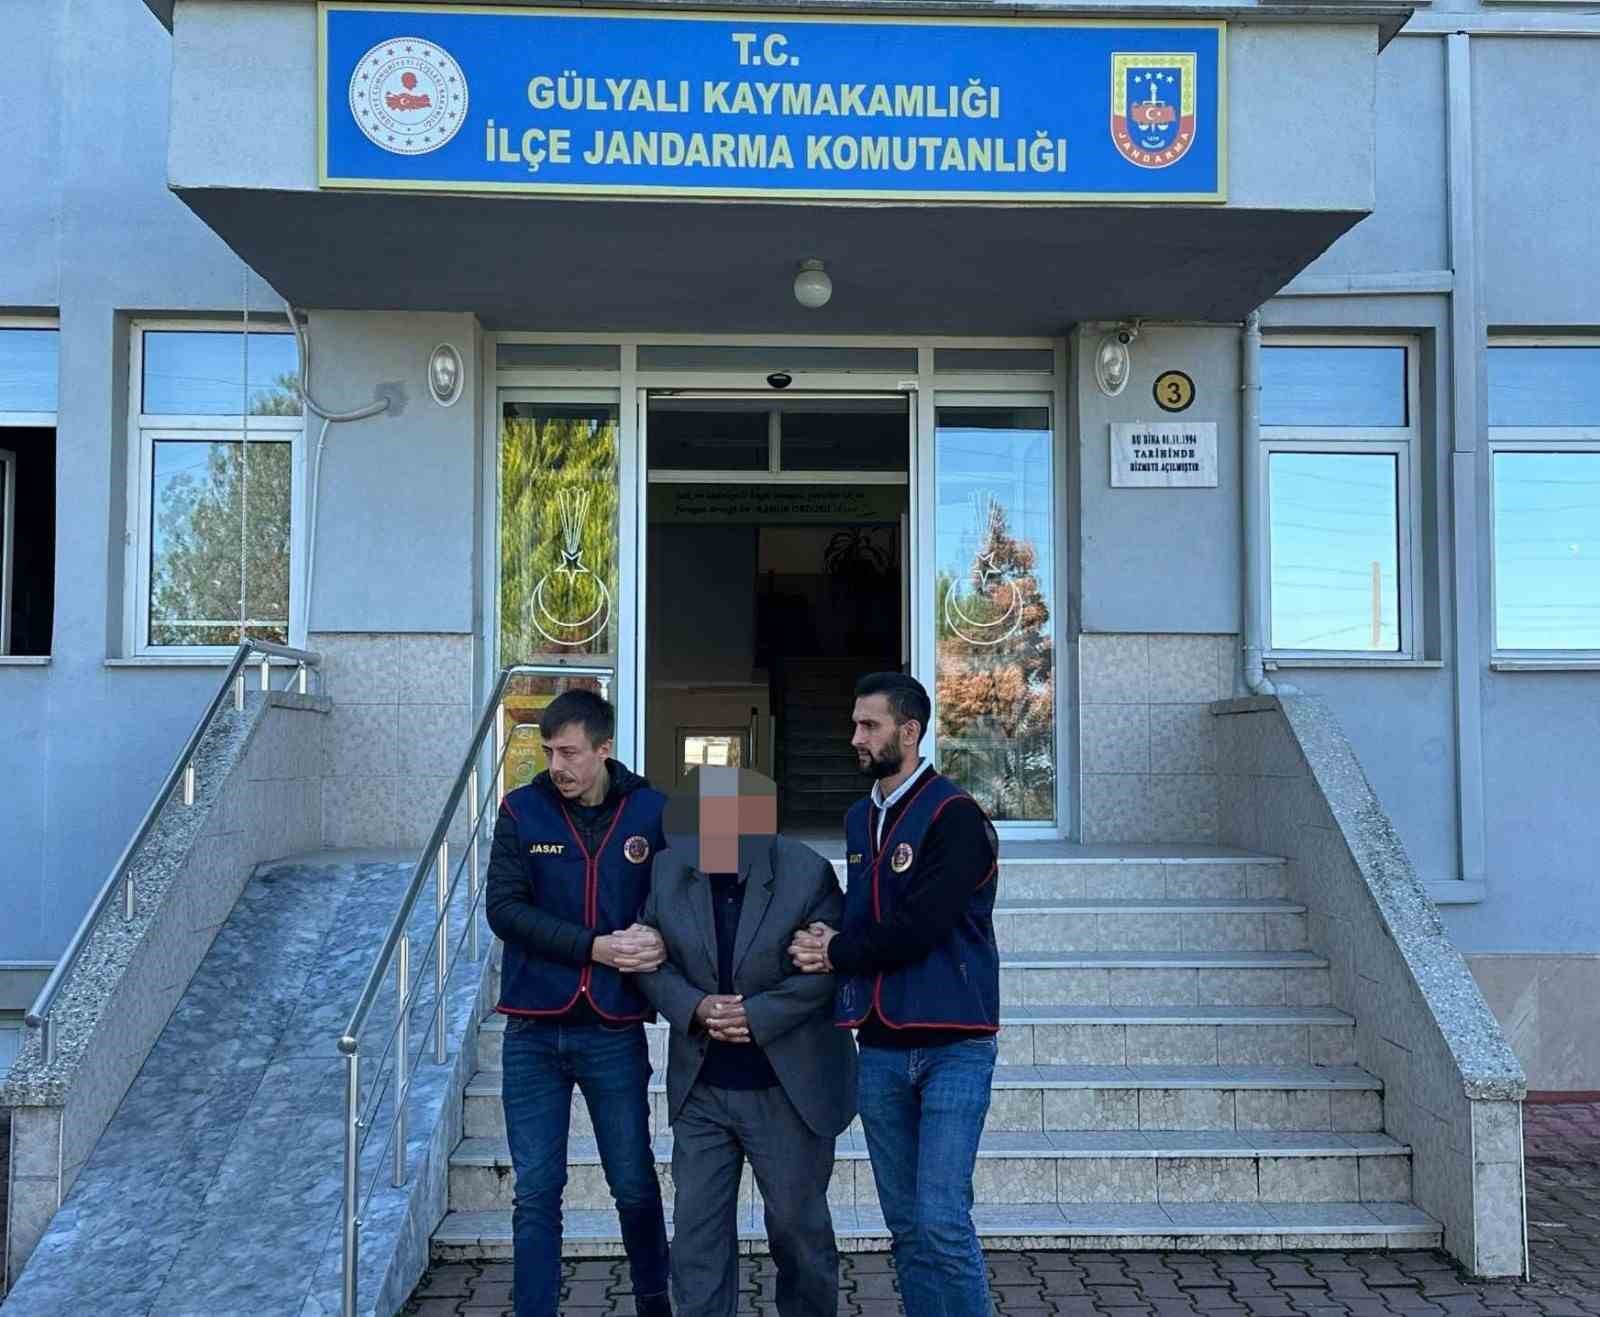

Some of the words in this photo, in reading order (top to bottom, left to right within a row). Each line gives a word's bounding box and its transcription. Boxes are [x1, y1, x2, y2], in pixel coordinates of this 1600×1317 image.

[731, 32, 800, 67] T.C.
[527, 70, 690, 113] GÜLYALI
[703, 78, 1000, 119] KAYMAKAMLIĞI
[486, 119, 571, 172] İLÇE
[583, 130, 794, 168] JANDARMA
[807, 130, 1067, 173] KOMUTANLIĞI
[1119, 132, 1189, 163] JANDARMA
[1167, 382, 1182, 404] 3
[1134, 448, 1195, 458] TARİHİNDE
[529, 844, 565, 855] JASAT
